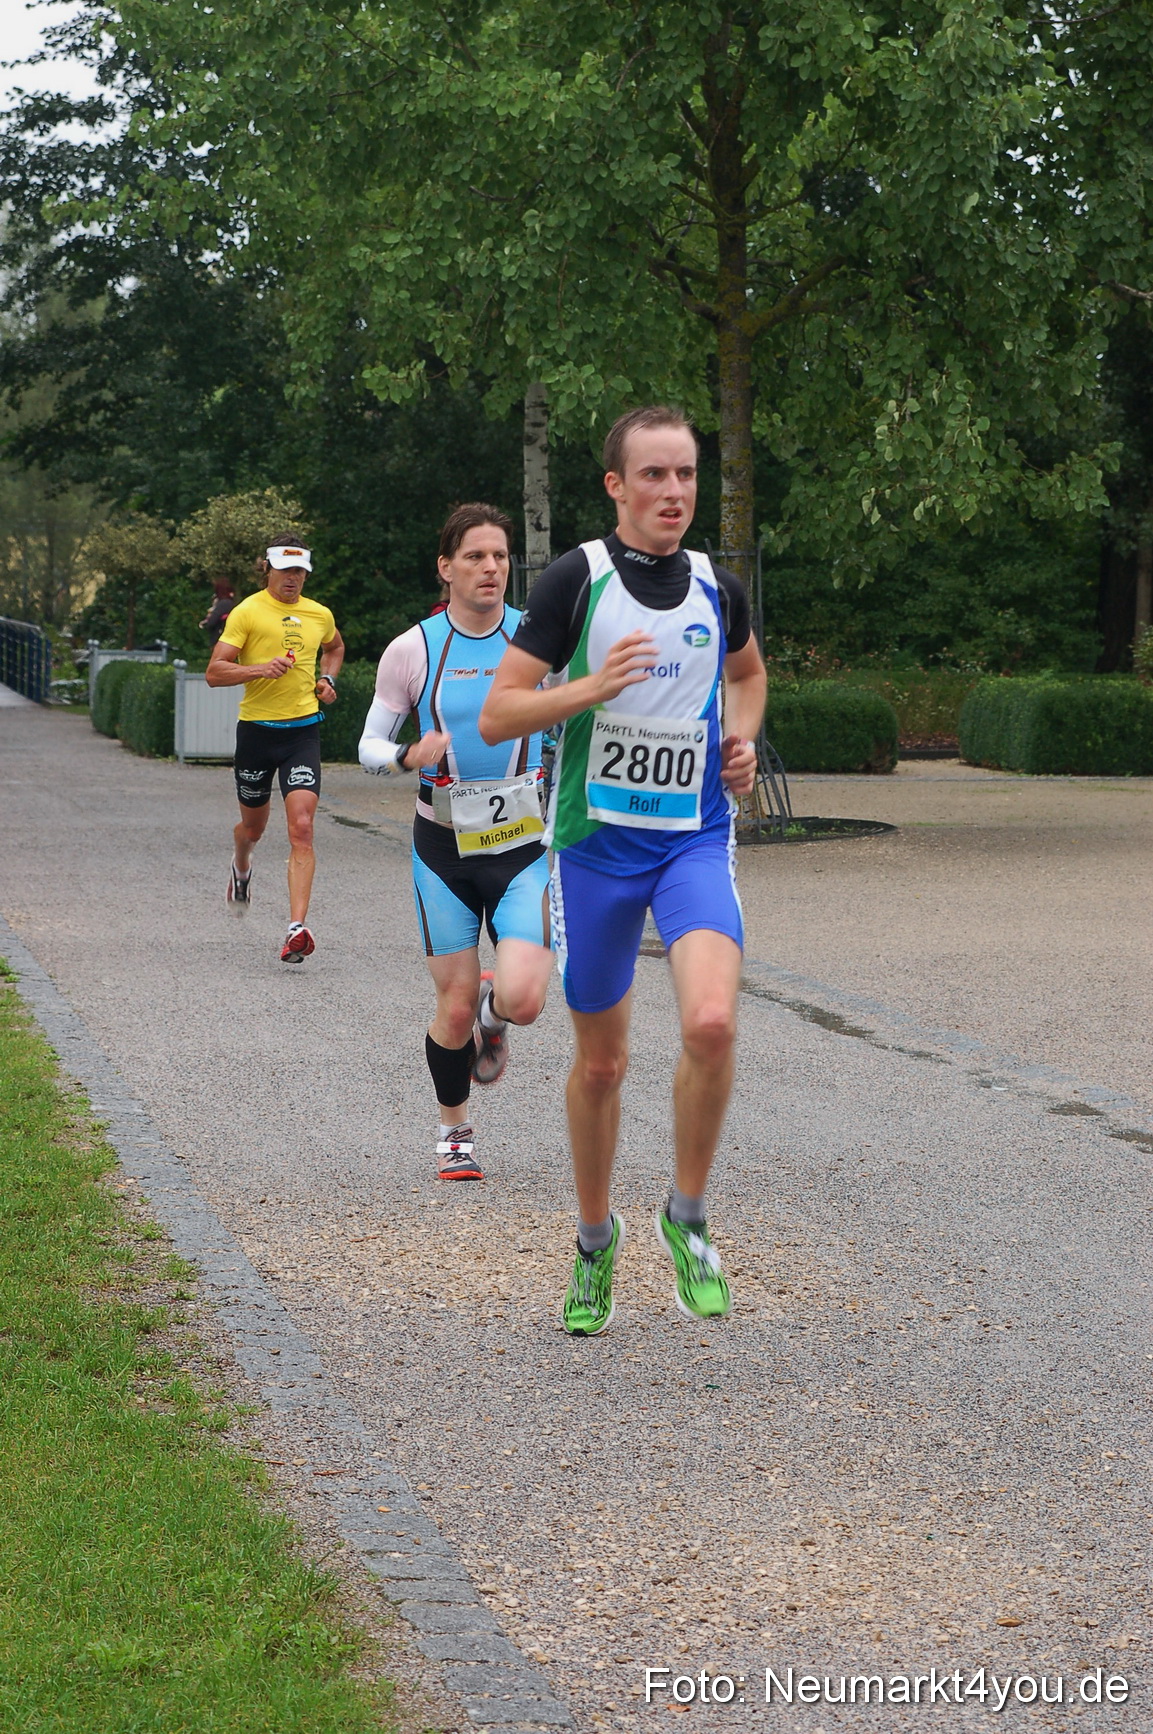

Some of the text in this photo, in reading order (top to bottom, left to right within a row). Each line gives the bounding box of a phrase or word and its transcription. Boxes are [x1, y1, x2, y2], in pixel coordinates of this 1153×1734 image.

[595, 721, 691, 742] PARTL Neumarkt
[600, 741, 695, 787] 2800
[452, 787, 480, 800] PARTL
[628, 795, 662, 813] Rolf
[488, 794, 508, 825] 2
[479, 823, 525, 847] Michael
